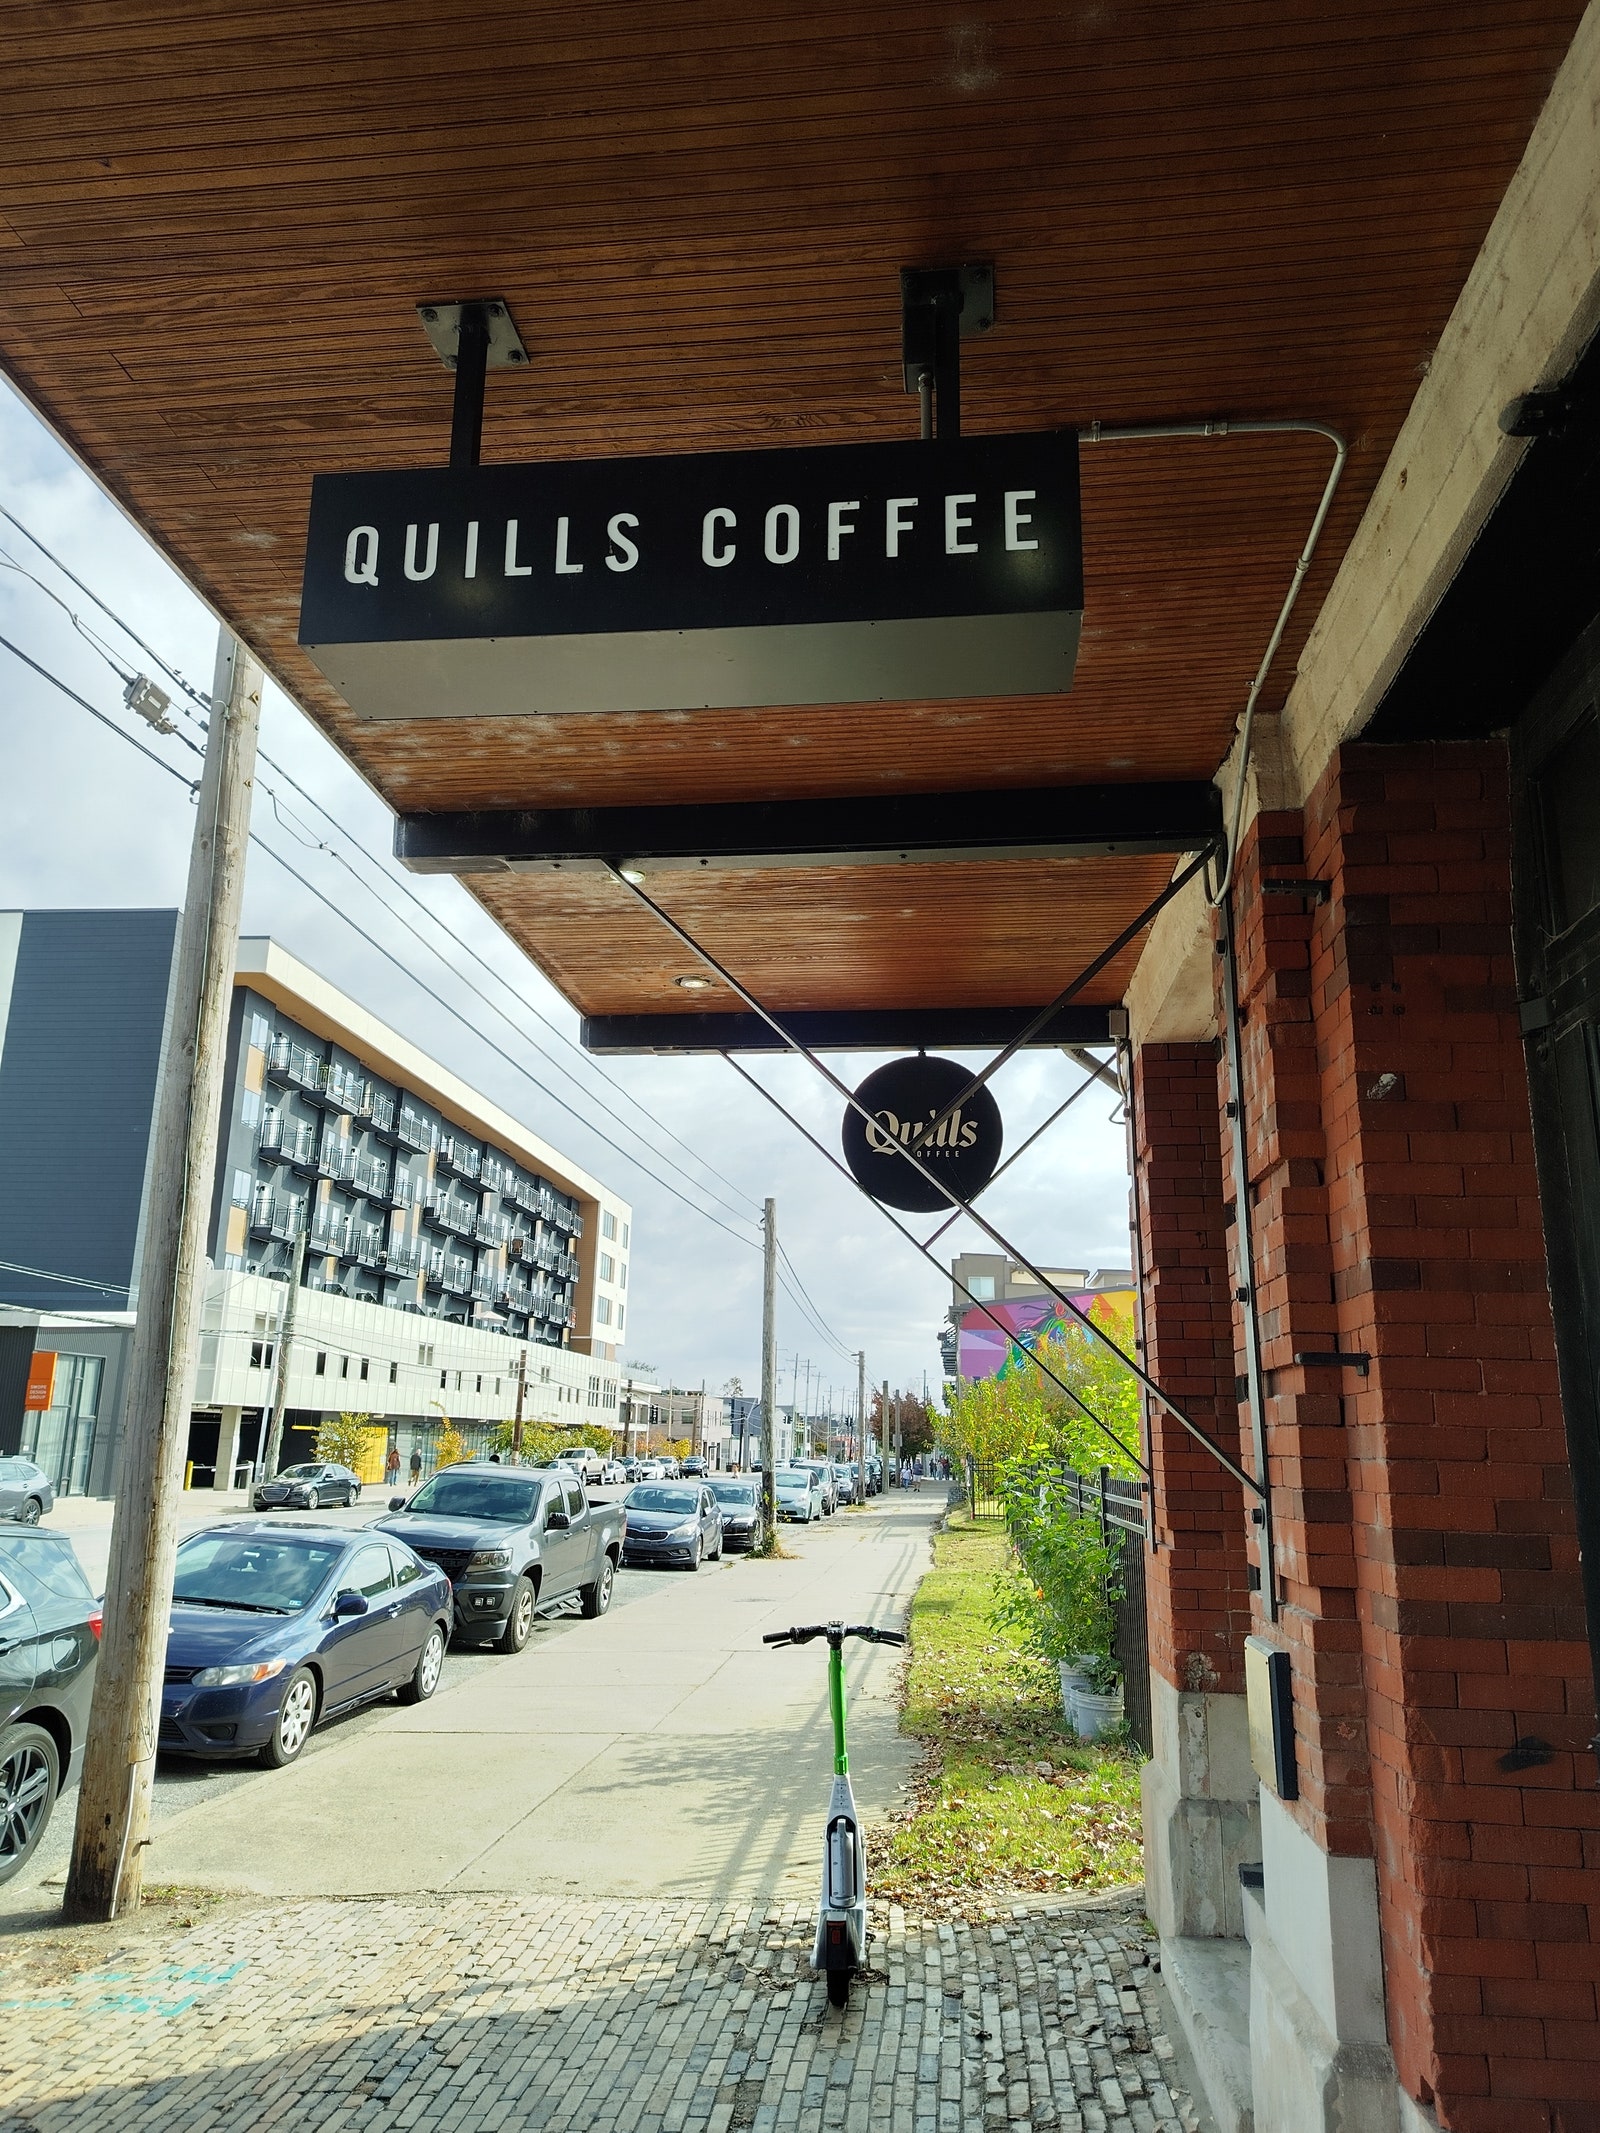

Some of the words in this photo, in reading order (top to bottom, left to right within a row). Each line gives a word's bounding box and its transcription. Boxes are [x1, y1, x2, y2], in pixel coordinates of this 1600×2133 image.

[344, 513, 639, 587] QUILLS
[702, 490, 1039, 568] COFFEE
[915, 1149, 960, 1158] OFFEE
